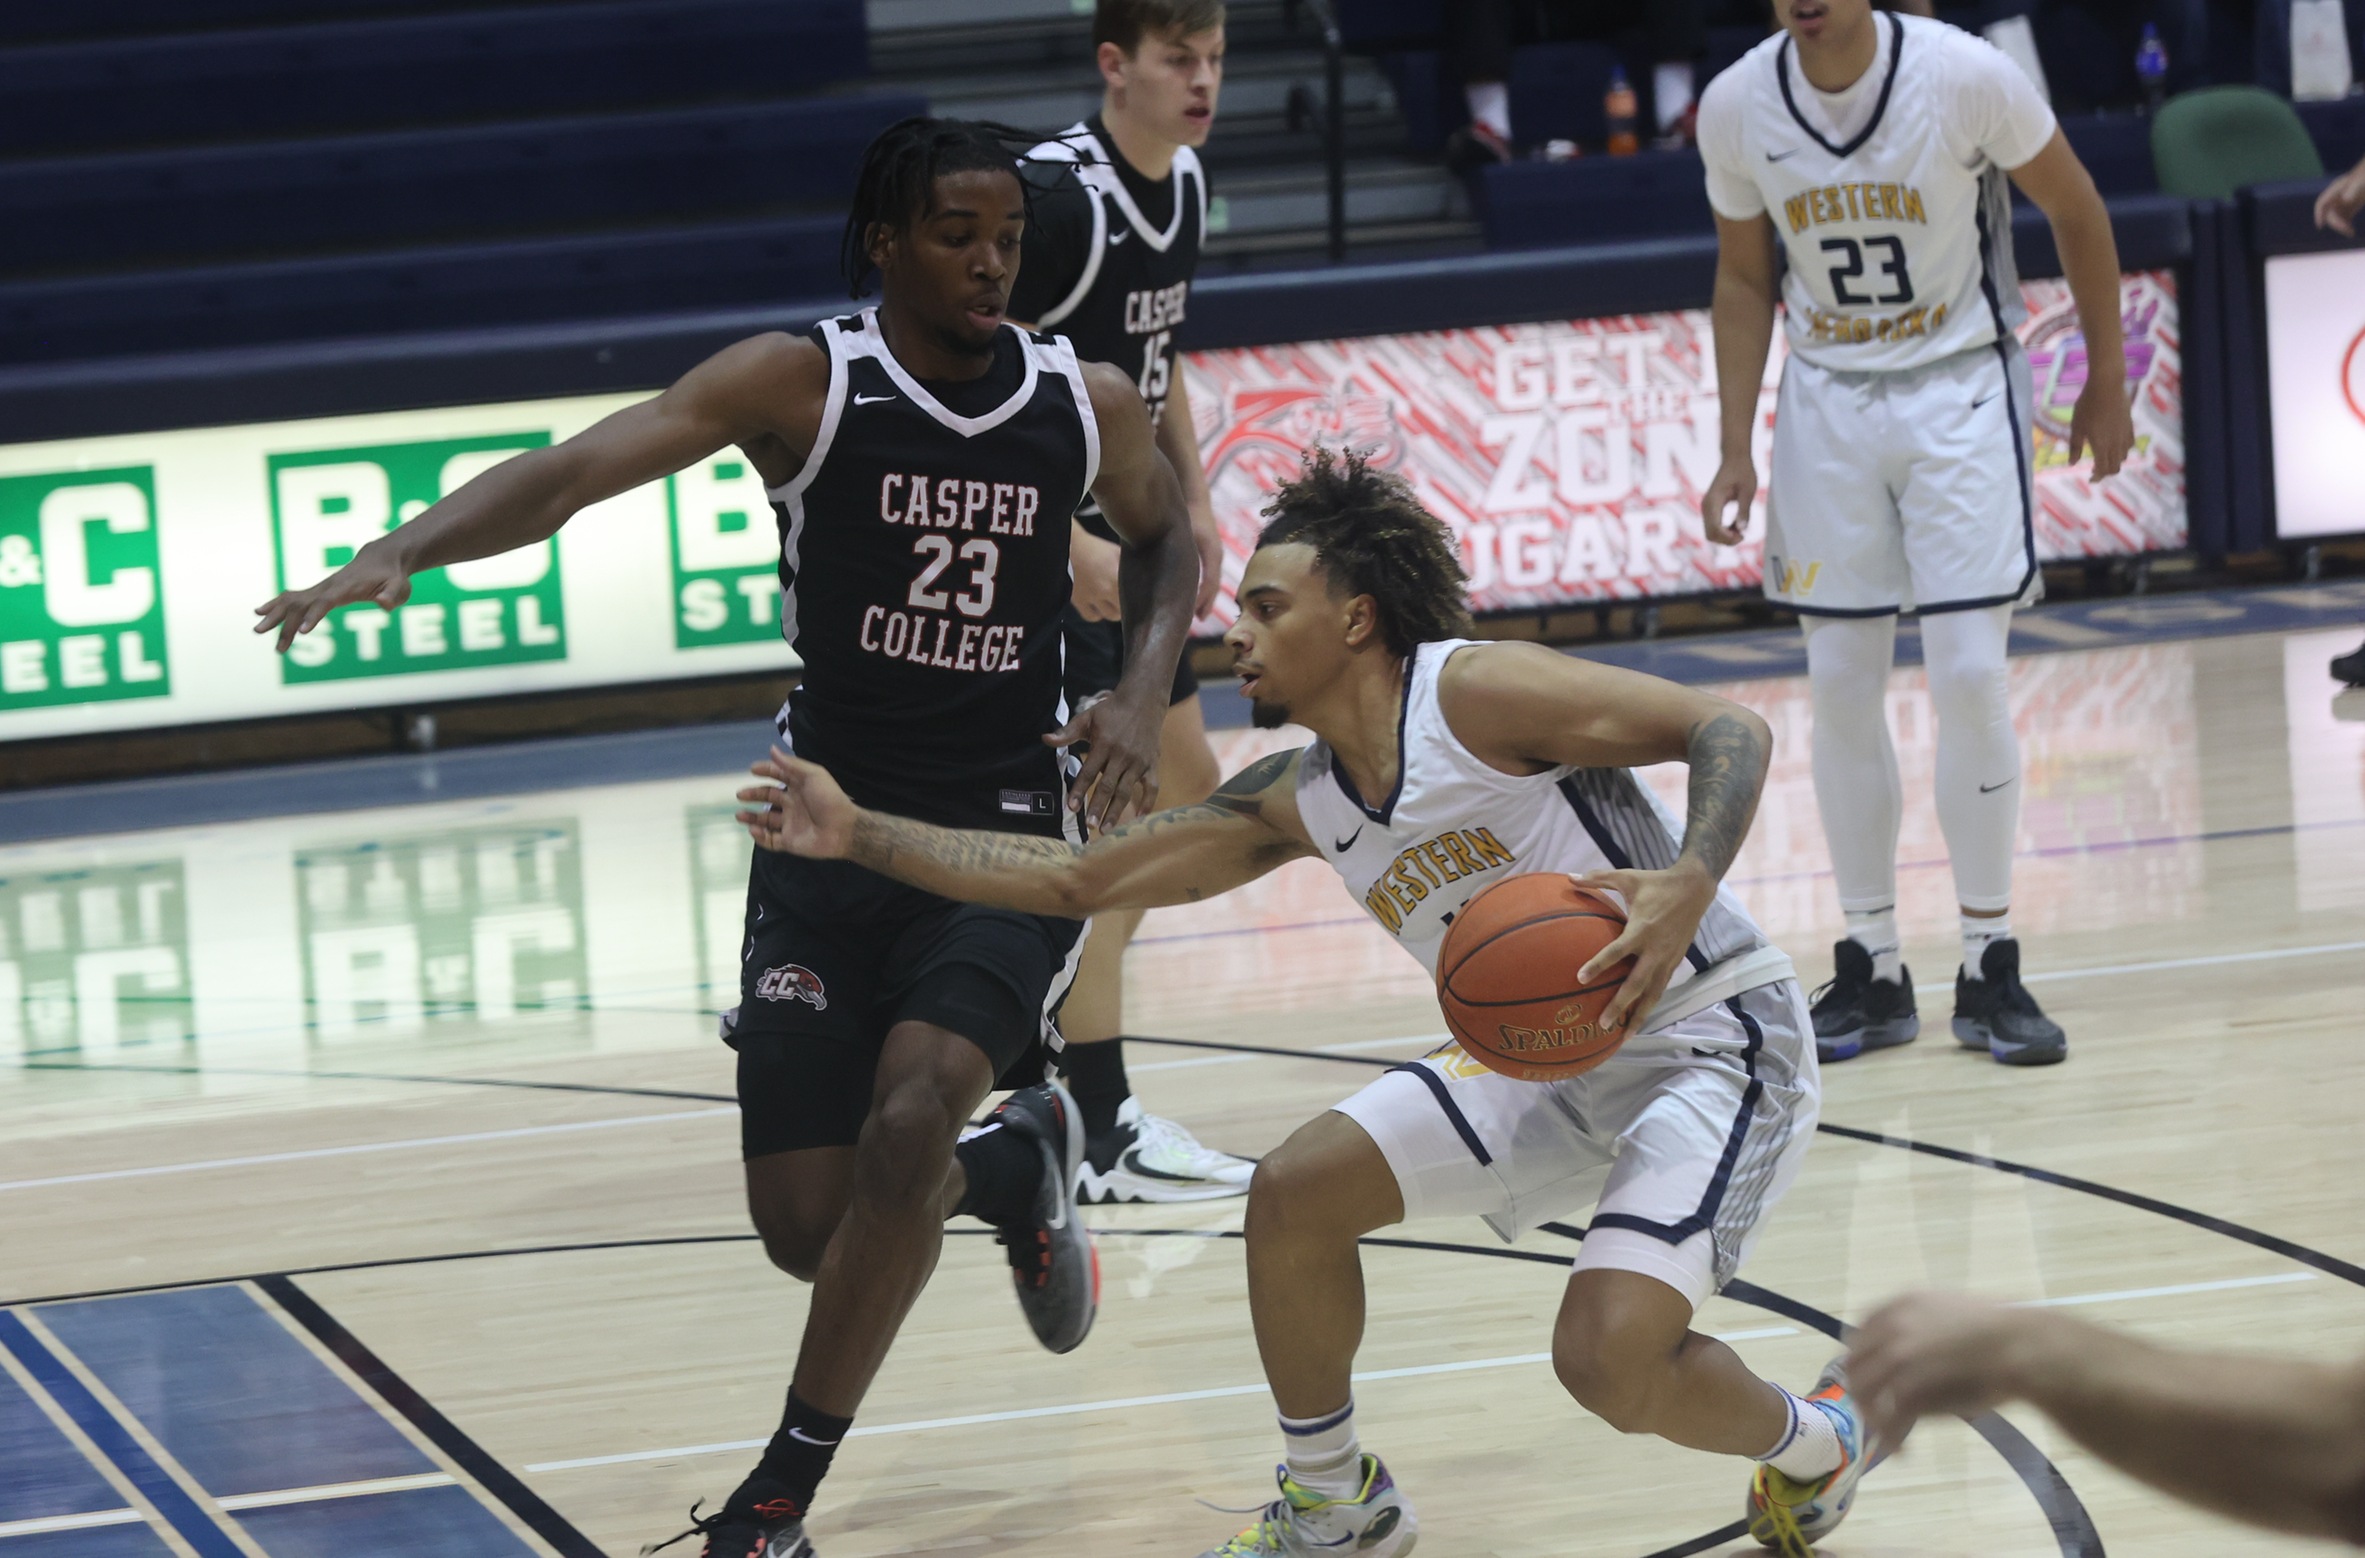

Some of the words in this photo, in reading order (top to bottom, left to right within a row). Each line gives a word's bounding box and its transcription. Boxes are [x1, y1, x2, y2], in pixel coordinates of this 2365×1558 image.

[1784, 181, 1927, 234] WESTERN
[1819, 233, 1915, 305] 23
[1139, 330, 1171, 399] 15
[1496, 331, 1661, 411] GET
[880, 473, 1040, 537] CASPER
[906, 533, 1000, 618] 23
[287, 594, 561, 668] STEEL
[859, 604, 1025, 673] COLLEGE
[1365, 826, 1516, 936] WESTERN
[760, 971, 801, 997] CC
[1498, 1007, 1632, 1052] SPALDIG
